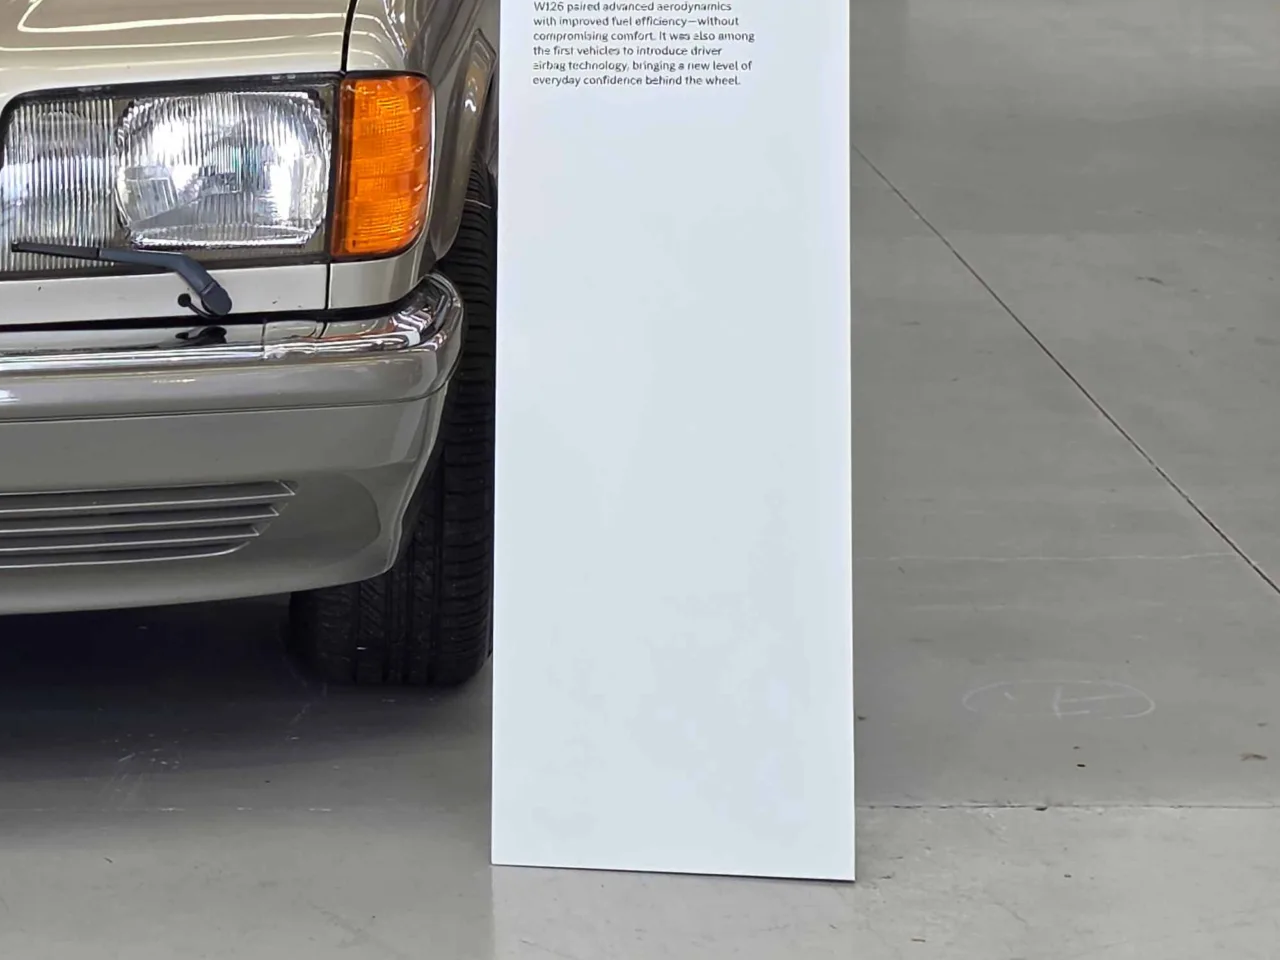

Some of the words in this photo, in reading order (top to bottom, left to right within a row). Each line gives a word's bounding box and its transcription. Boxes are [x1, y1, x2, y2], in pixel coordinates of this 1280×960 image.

[534, 1, 564, 12] W126
[567, 1, 600, 14] paired
[602, 1, 654, 12] advanced
[656, 1, 732, 14] aerodynamics
[533, 16, 556, 26] with
[559, 16, 609, 28] improved
[612, 16, 632, 26] fuel
[533, 31, 608, 43] compromising
[611, 30, 656, 41] comfort.
[659, 31, 667, 41] It
[669, 33, 690, 41] was
[693, 31, 716, 41] also
[718, 33, 755, 44] among
[533, 45, 550, 55] the
[553, 45, 574, 55] first
[577, 45, 620, 55] vehicles
[623, 46, 634, 55] to
[636, 45, 688, 56] introduce
[691, 45, 722, 56] driver
[533, 60, 565, 72] airbag
[568, 60, 629, 72] technology,
[632, 60, 676, 73] bringing
[688, 63, 710, 71] new
[713, 60, 738, 71] level
[740, 60, 753, 71] of
[533, 75, 581, 87] everyday
[583, 75, 642, 85] confidence
[645, 75, 682, 85] behind
[685, 75, 703, 85] the
[706, 75, 741, 85] wheel.
